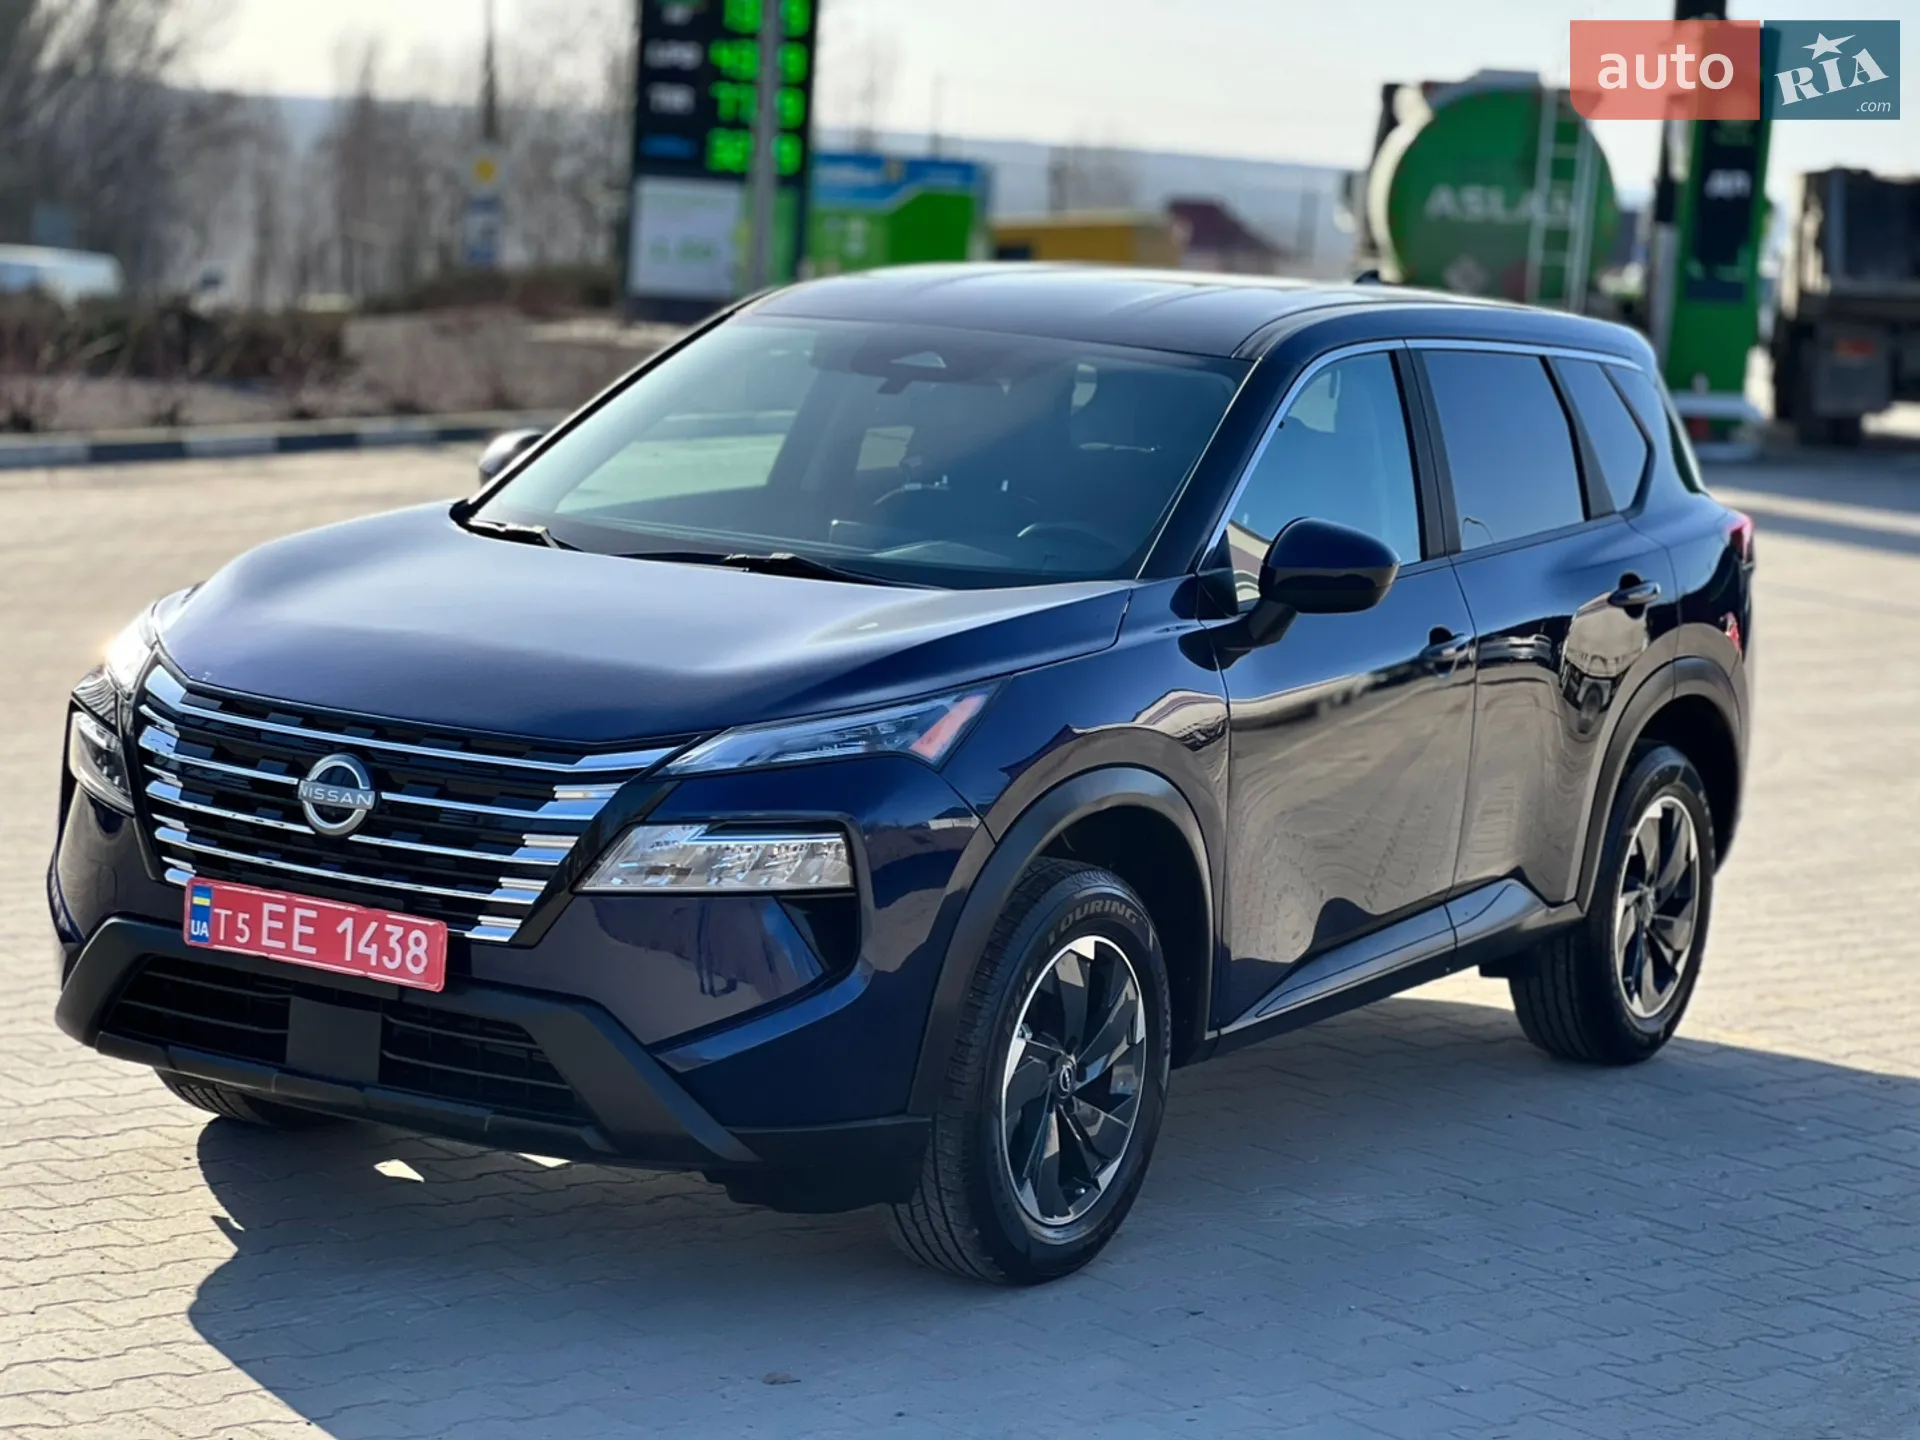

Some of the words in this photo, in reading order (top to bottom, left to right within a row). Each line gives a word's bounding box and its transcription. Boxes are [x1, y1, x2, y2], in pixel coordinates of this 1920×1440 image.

[299, 785, 373, 806] NISSAN
[190, 919, 210, 938] UA
[214, 908, 250, 944] T5
[261, 902, 318, 955] EE
[336, 917, 429, 975] 1438
